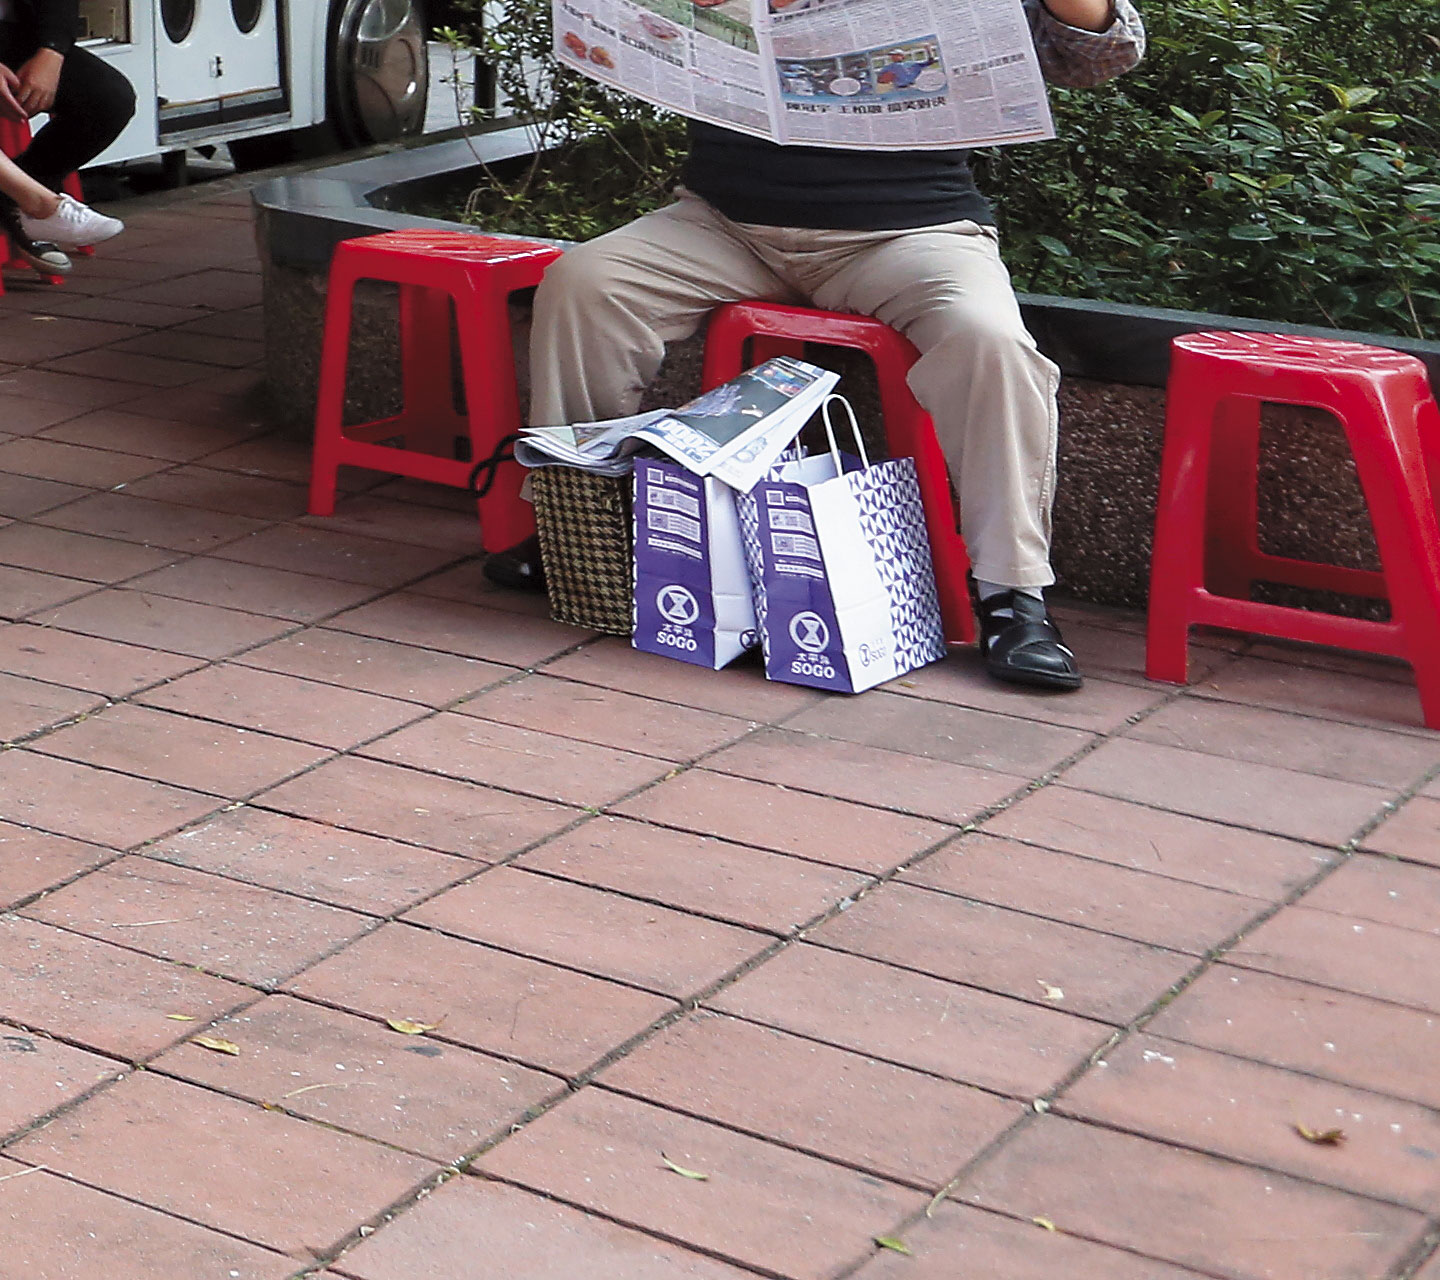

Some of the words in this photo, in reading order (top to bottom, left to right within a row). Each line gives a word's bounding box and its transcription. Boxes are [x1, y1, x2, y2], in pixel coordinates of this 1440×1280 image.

[662, 623, 695, 638] 太平洋
[656, 632, 698, 653] SOGO
[796, 653, 830, 665] 太平洋
[791, 661, 835, 679] SOGO
